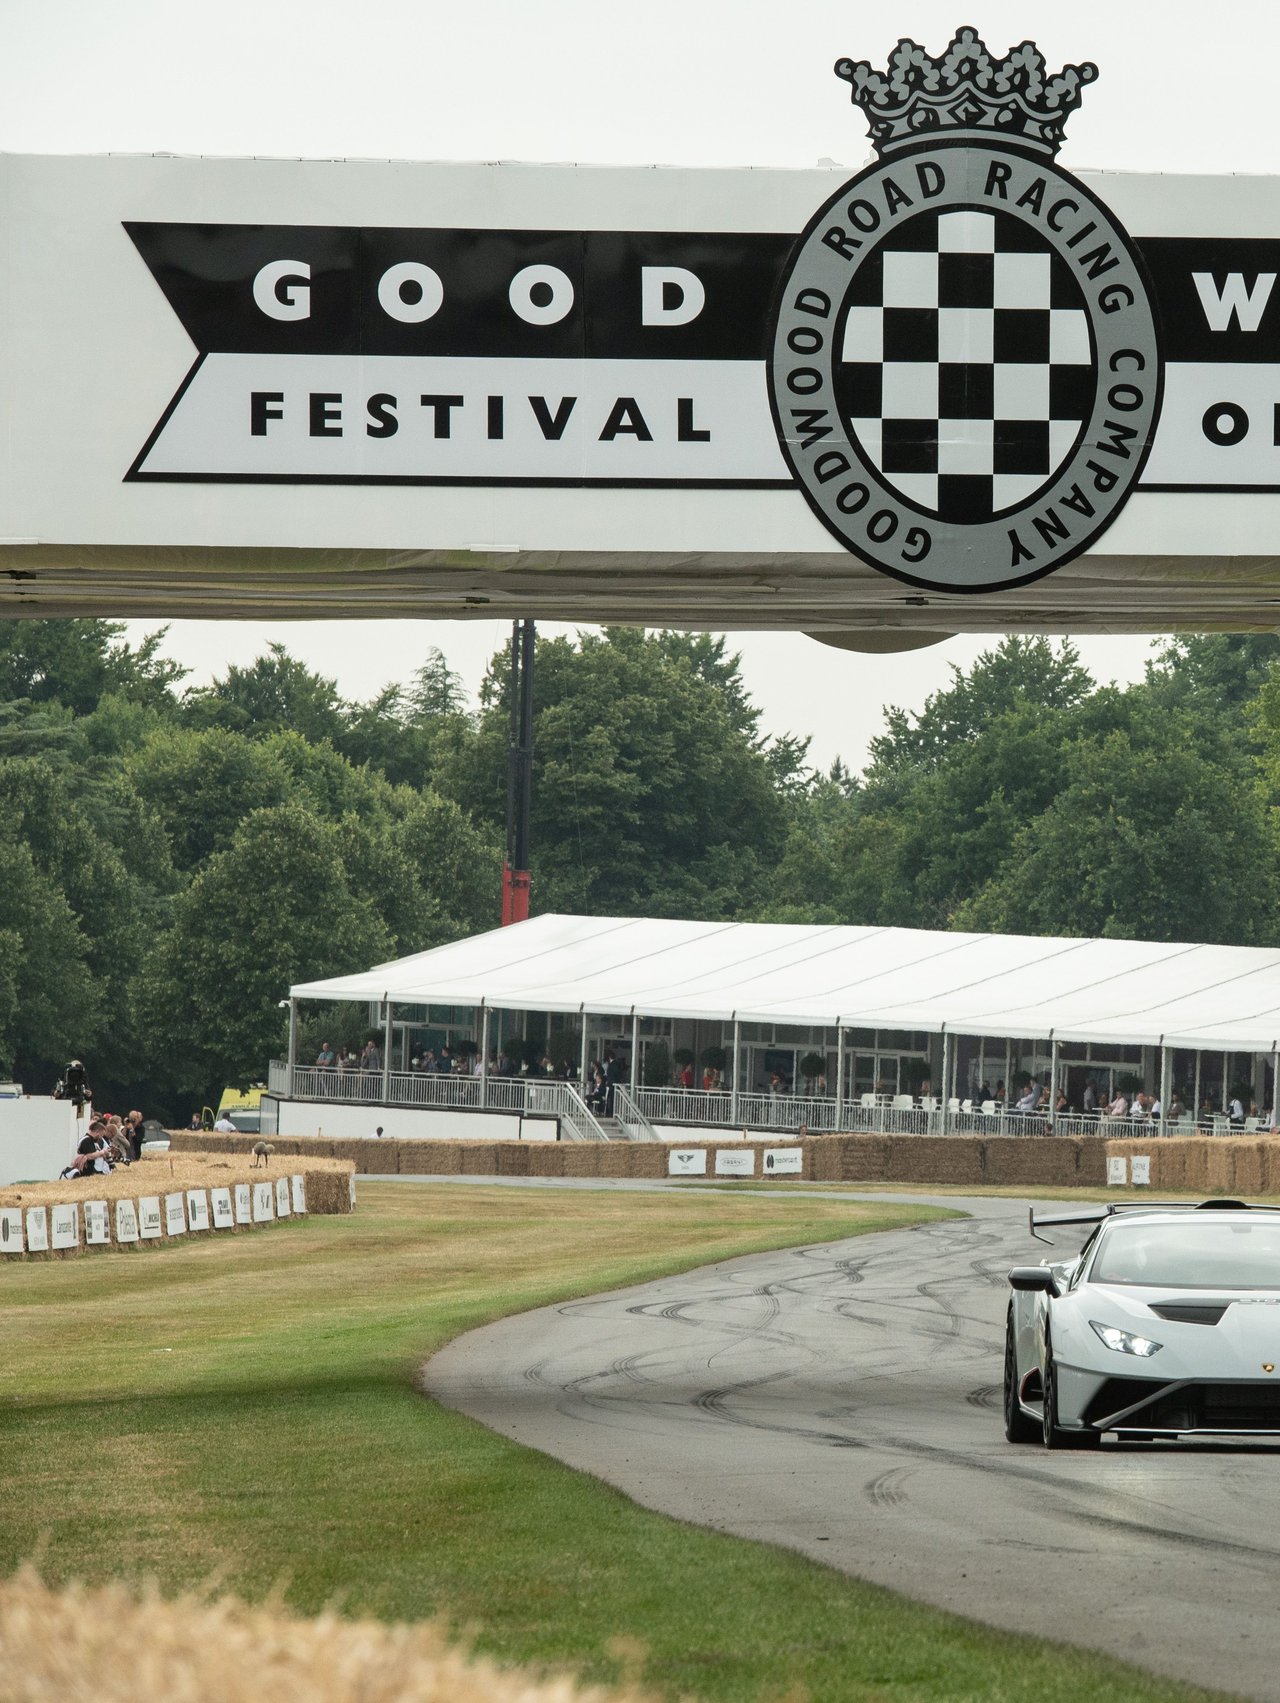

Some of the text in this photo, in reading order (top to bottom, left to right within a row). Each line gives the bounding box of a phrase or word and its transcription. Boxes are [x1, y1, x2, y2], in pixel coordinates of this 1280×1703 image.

[252, 259, 706, 326] GOOD
[786, 159, 1146, 568] GOODWOOD ROAD RACING COMPANY
[250, 391, 711, 443] FESTIVAL
